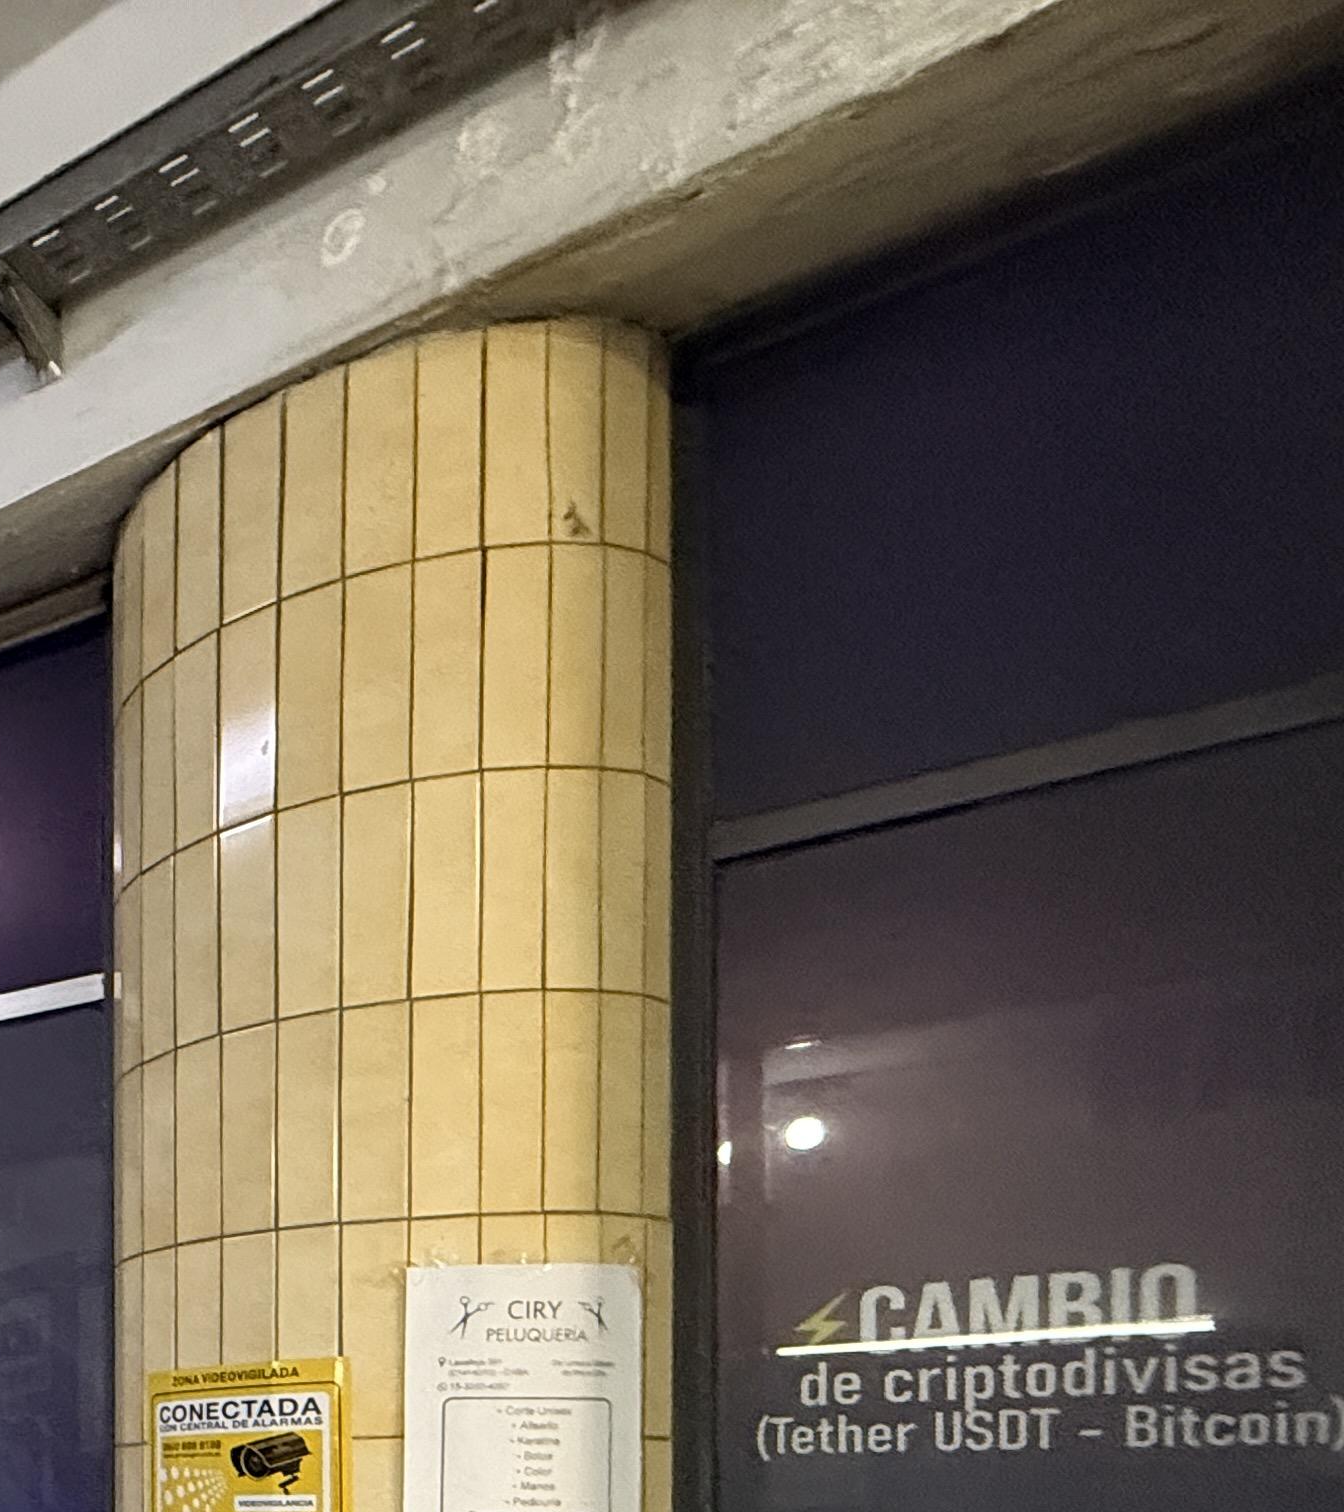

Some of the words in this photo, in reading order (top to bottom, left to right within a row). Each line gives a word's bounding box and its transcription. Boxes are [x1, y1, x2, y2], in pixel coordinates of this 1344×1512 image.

[507, 1300, 562, 1319] CIRY
[859, 1263, 1199, 1353] CAMBIO
[202, 1367, 300, 1384] VIDEOVIGILADA
[800, 1363, 862, 1407] de
[883, 1344, 1307, 1418] criptodivisas
[160, 1397, 321, 1424] CONECTADA
[180, 1420, 228, 1431] CENTRAL
[232, 1419, 249, 1428] DE
[252, 1416, 323, 1427] ALARMAS
[757, 1415, 917, 1461] (Tether
[934, 1408, 1060, 1451] USDT
